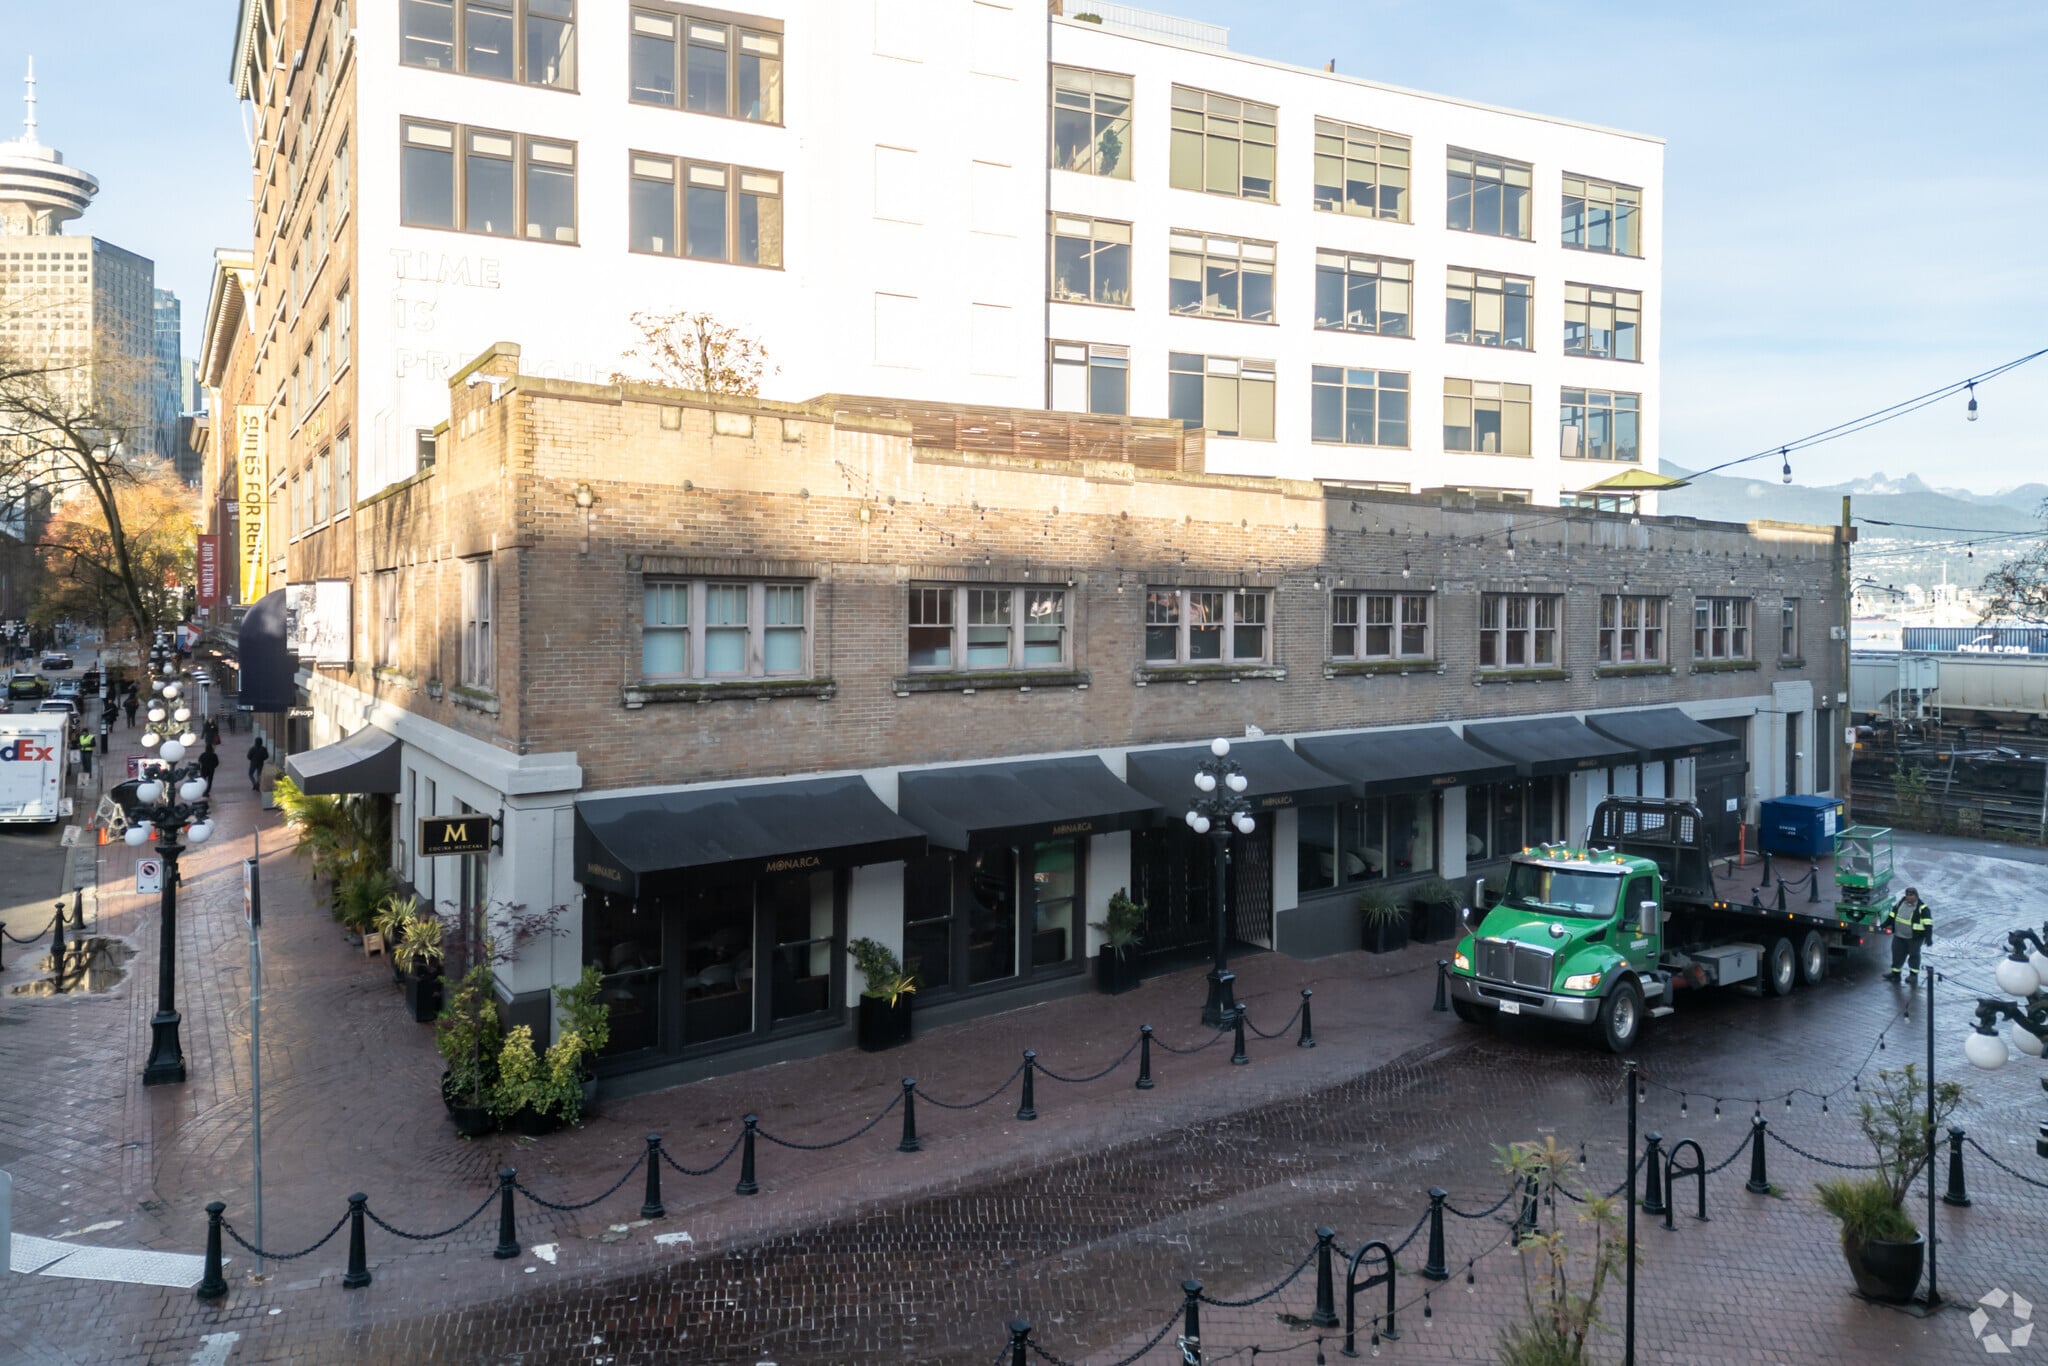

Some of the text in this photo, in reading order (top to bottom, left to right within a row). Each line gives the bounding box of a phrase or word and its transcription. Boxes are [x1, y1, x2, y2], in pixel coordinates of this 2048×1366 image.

[390, 248, 500, 289] TIME
[397, 299, 436, 332] IS
[244, 415, 262, 567] SUITES FOR RENT
[289, 709, 313, 717] Aesop
[443, 823, 467, 843] M
[766, 856, 821, 872] MONARCA
